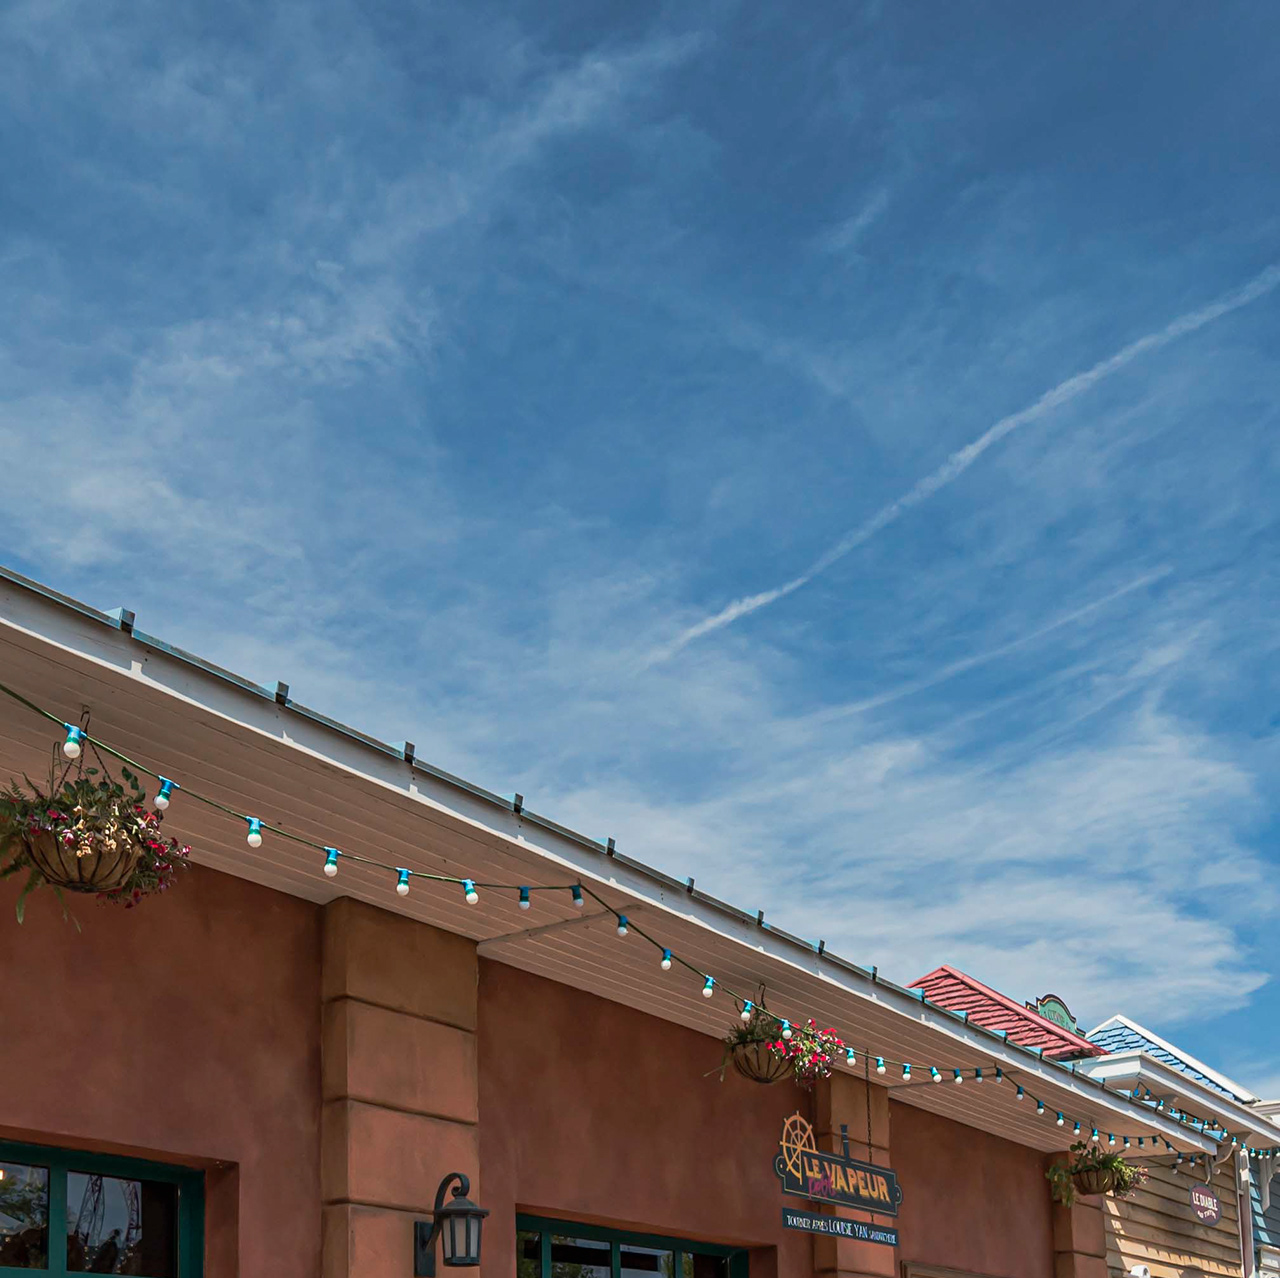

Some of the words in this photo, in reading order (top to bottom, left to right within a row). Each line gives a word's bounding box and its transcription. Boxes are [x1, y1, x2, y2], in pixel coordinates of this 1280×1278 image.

[803, 1156, 821, 1178] LE
[823, 1161, 891, 1203] VAPEUR
[1192, 1191, 1200, 1206] LE
[1200, 1194, 1218, 1211] DIABLE
[786, 1215, 811, 1229] TOURNER
[854, 1225, 868, 1239] YAN
